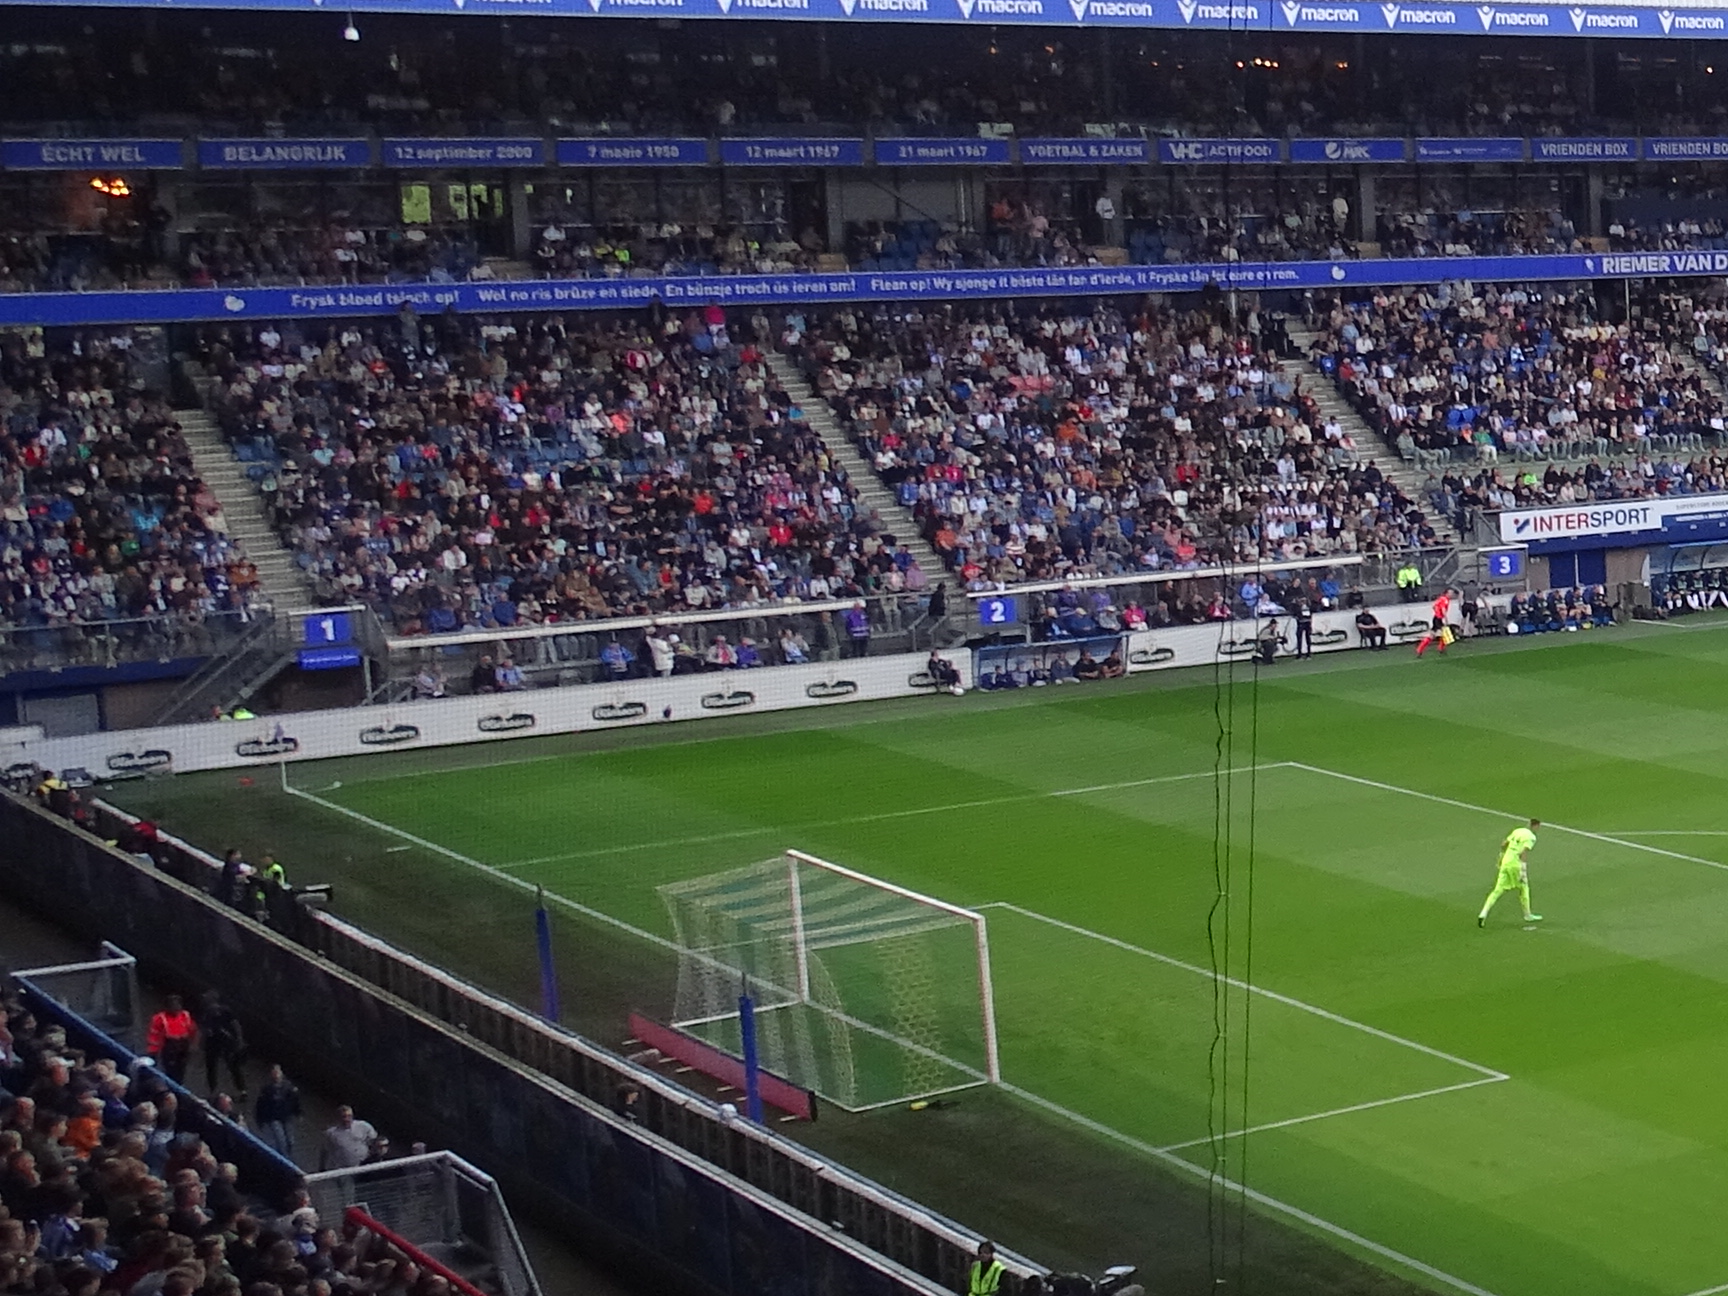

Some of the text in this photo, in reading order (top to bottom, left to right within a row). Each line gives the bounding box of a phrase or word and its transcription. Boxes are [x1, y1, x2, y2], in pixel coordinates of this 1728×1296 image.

[1090, 1, 1152, 16] macron
[1197, 2, 1257, 19] macron
[1301, 4, 1358, 22] macron
[1400, 7, 1455, 23] macron
[1495, 10, 1548, 26] macron
[1586, 13, 1637, 28] macron
[1675, 15, 1723, 29] macron
[101, 145, 146, 162] WEL
[223, 145, 346, 162] BELANGRIJK
[1028, 144, 1086, 157] VOETBAL
[1541, 142, 1628, 155] VRIENDEN BOX
[1652, 142, 1710, 155] VRIENDEN
[1602, 255, 1670, 274] RIEMER
[1673, 253, 1712, 271] VAN
[291, 293, 334, 310] Frysk
[1533, 507, 1650, 532] INTERSPORT
[1500, 556, 1511, 574] 3
[990, 601, 1005, 622] 2
[321, 618, 335, 641] 1
